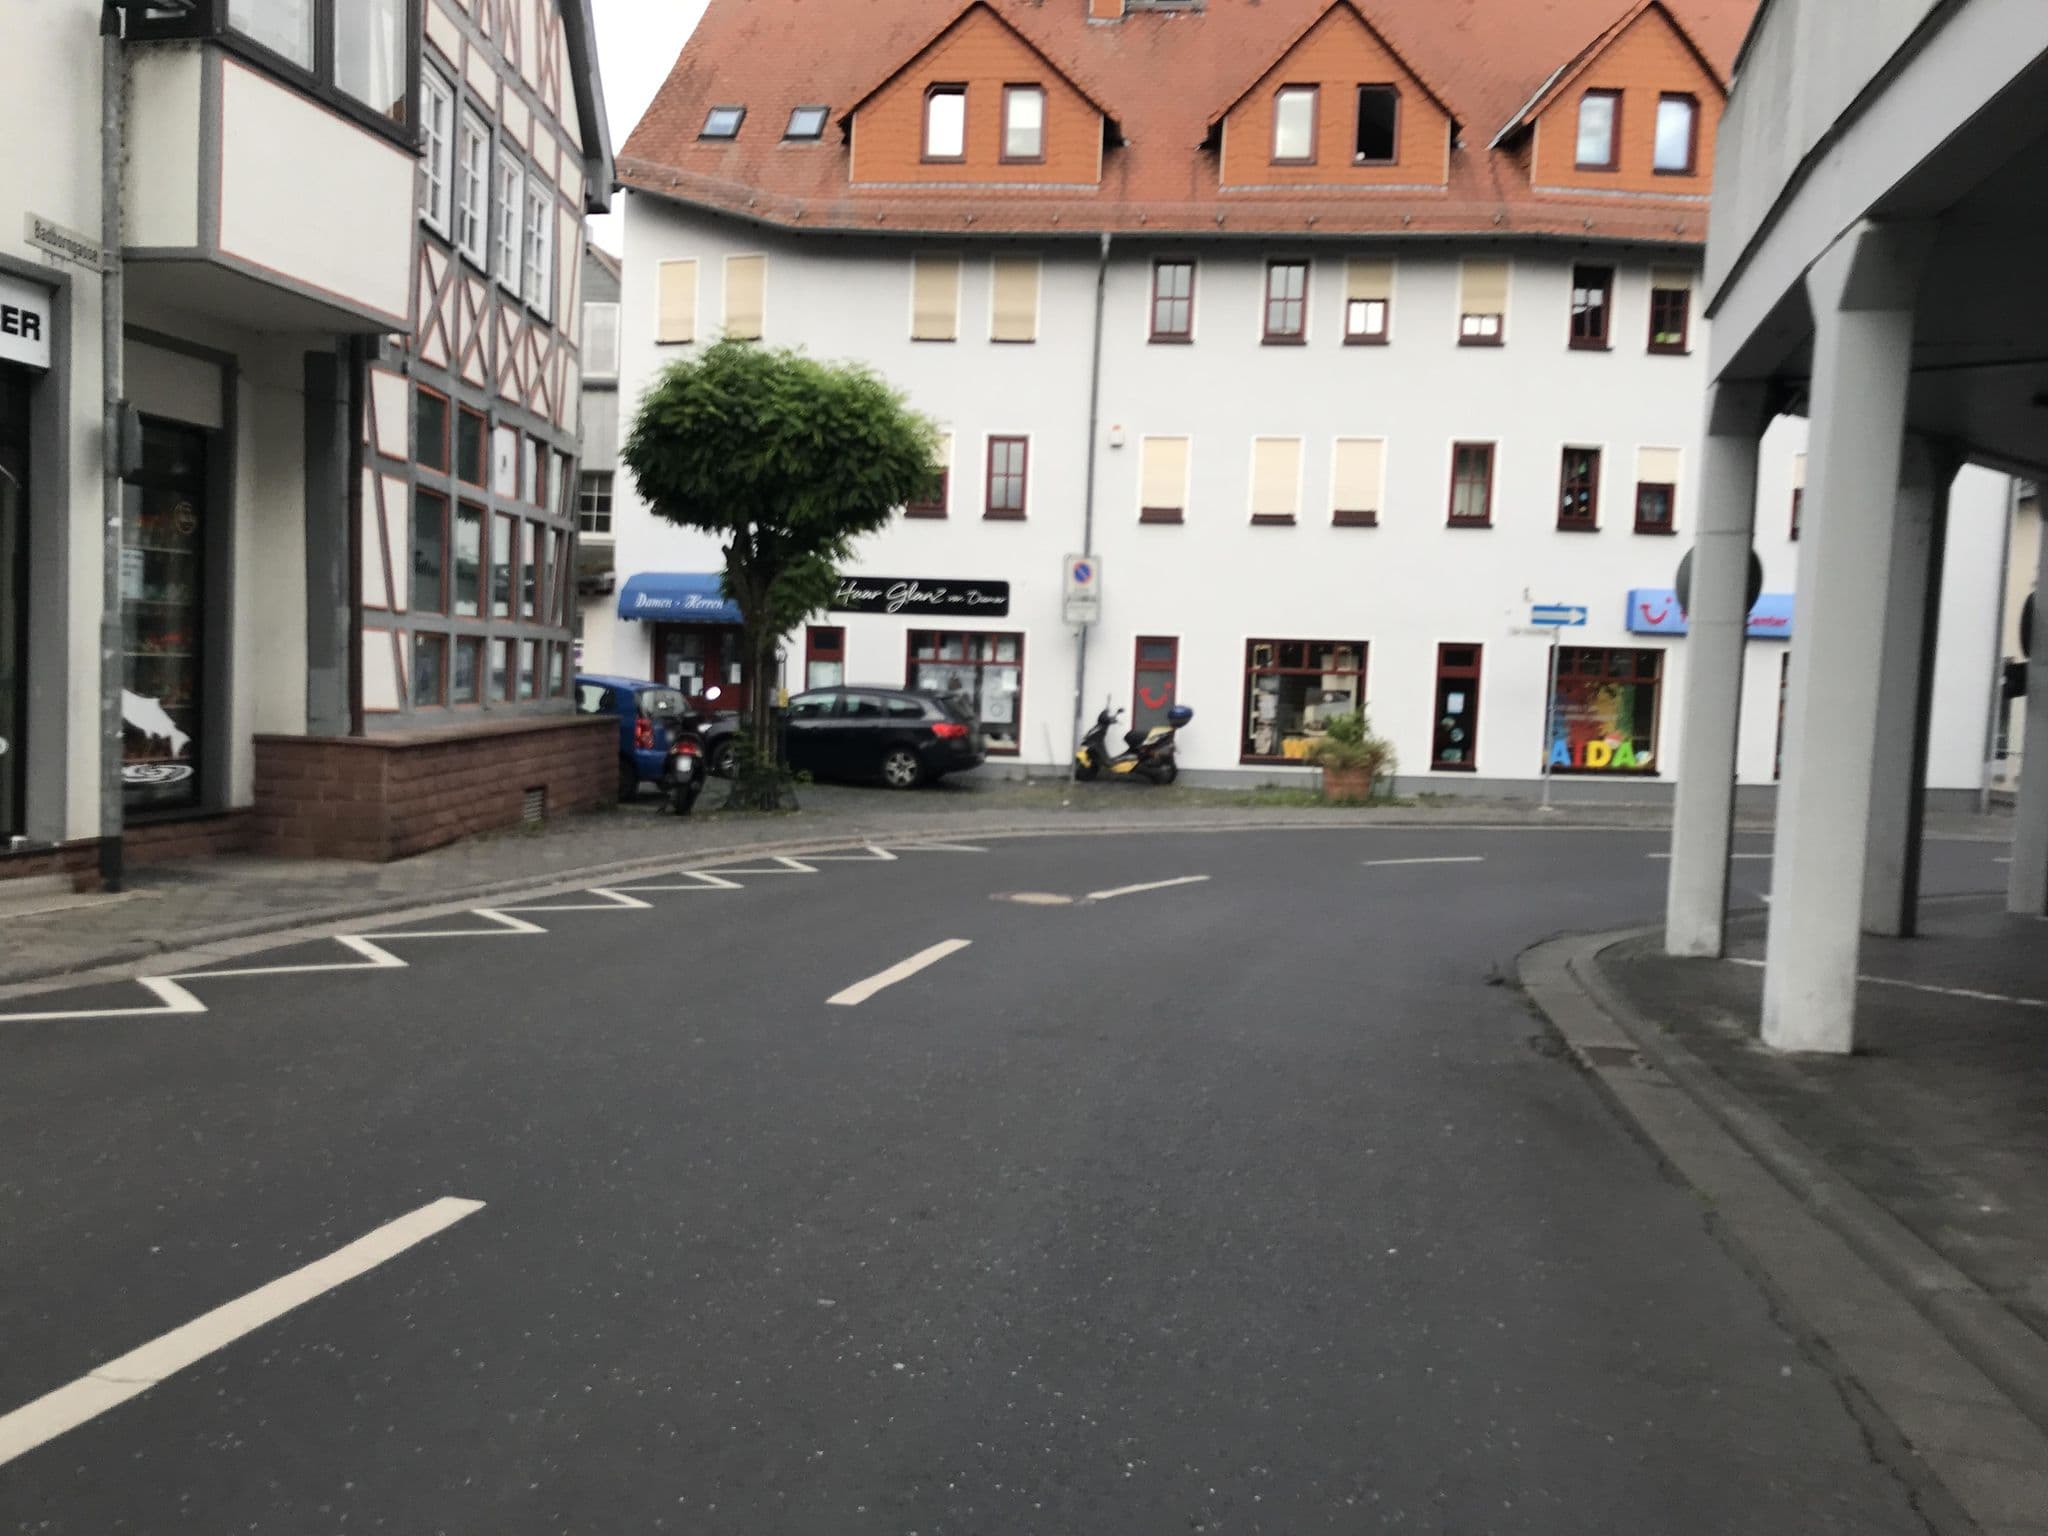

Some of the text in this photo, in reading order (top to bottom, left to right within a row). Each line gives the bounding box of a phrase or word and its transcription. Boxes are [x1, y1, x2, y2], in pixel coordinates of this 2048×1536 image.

[635, 591, 673, 609] Damen
[684, 594, 725, 610] Herren
[835, 579, 882, 607] Haar
[1549, 737, 1637, 769] AIDA
